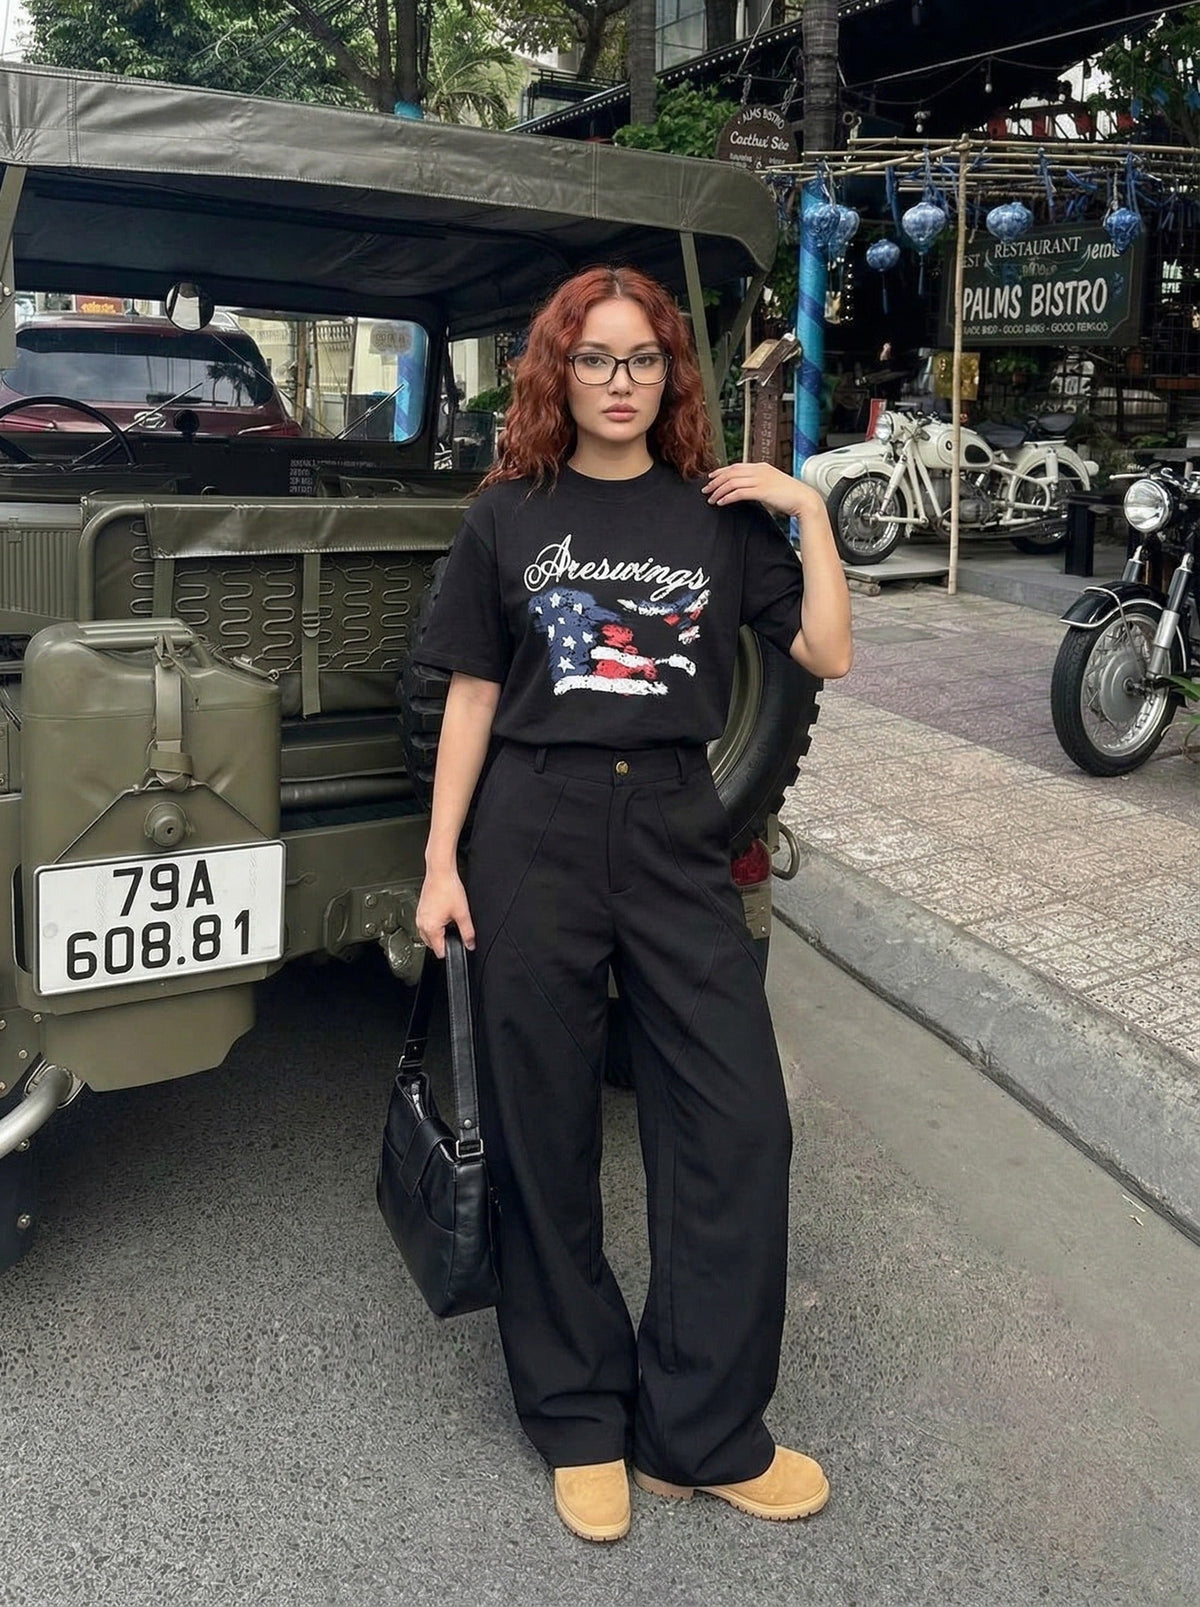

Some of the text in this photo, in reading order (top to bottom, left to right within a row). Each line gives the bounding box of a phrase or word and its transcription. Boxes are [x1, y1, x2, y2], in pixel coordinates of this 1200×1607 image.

[994, 236, 1082, 259] RESTAURANT
[962, 277, 1109, 321] PALMS BISTRO
[524, 534, 711, 602] Areswings
[113, 859, 215, 917] 79A
[66, 908, 250, 981] 608.81
